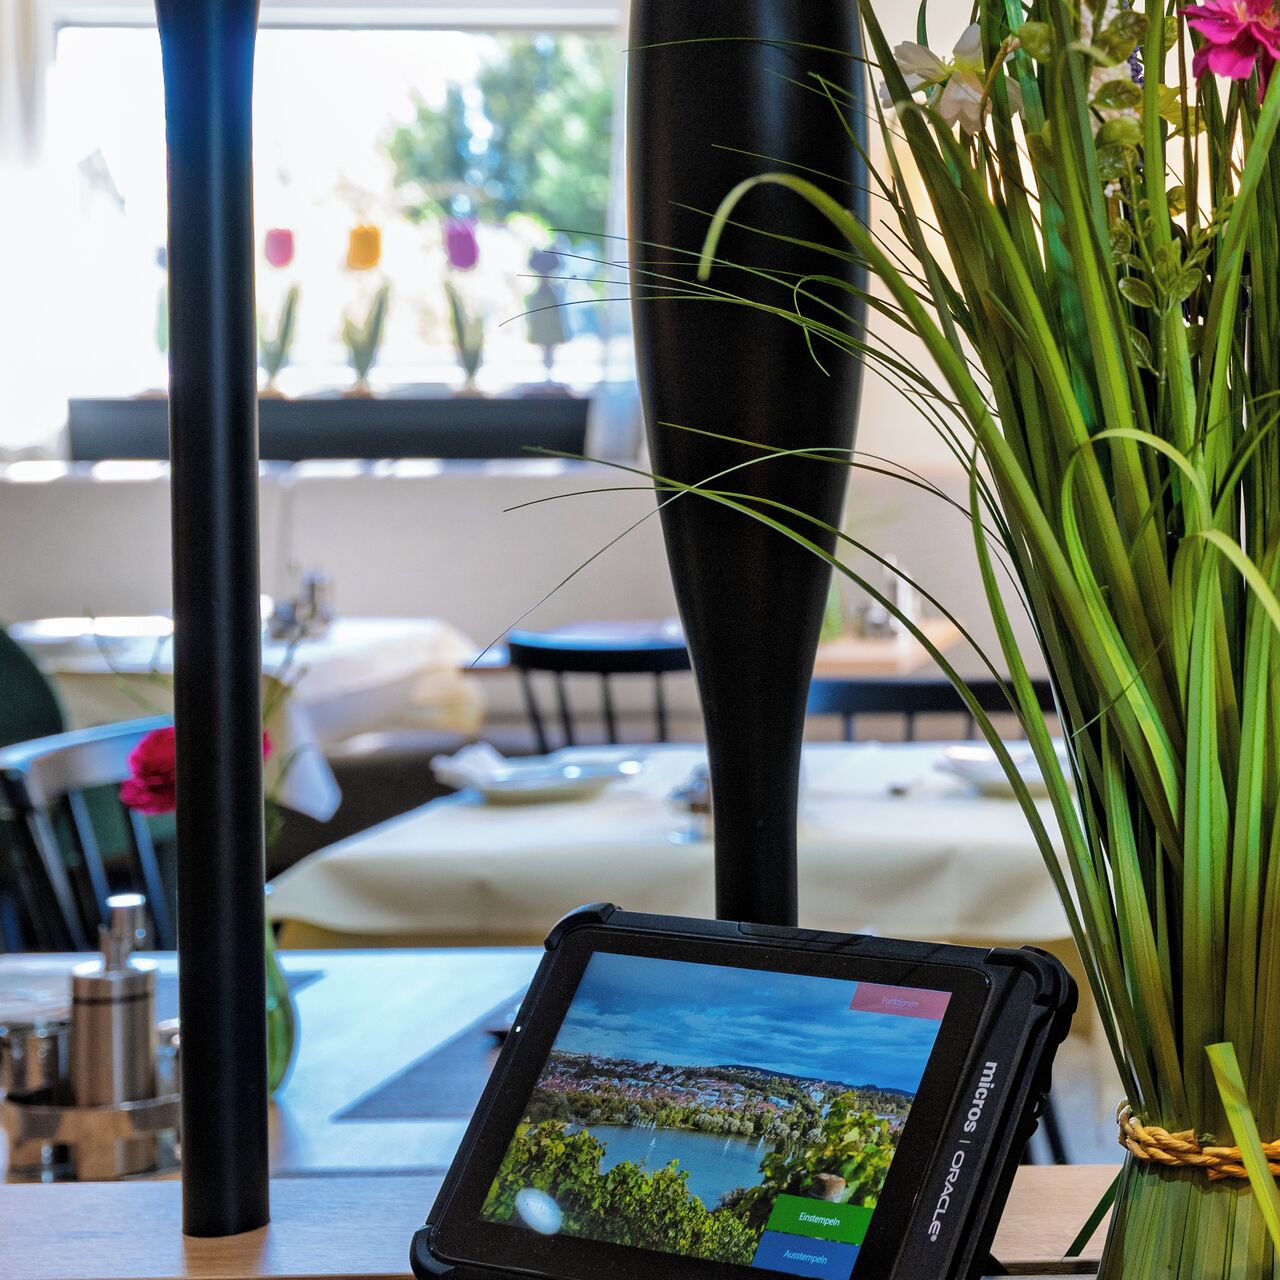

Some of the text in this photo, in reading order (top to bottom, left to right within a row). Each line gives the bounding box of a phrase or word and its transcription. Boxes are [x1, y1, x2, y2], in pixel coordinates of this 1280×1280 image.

[881, 996, 919, 1009] Funktionen
[963, 1061, 998, 1133] micros
[798, 1212, 841, 1227] Einstempeln
[783, 1250, 828, 1265] Ausstempeln
